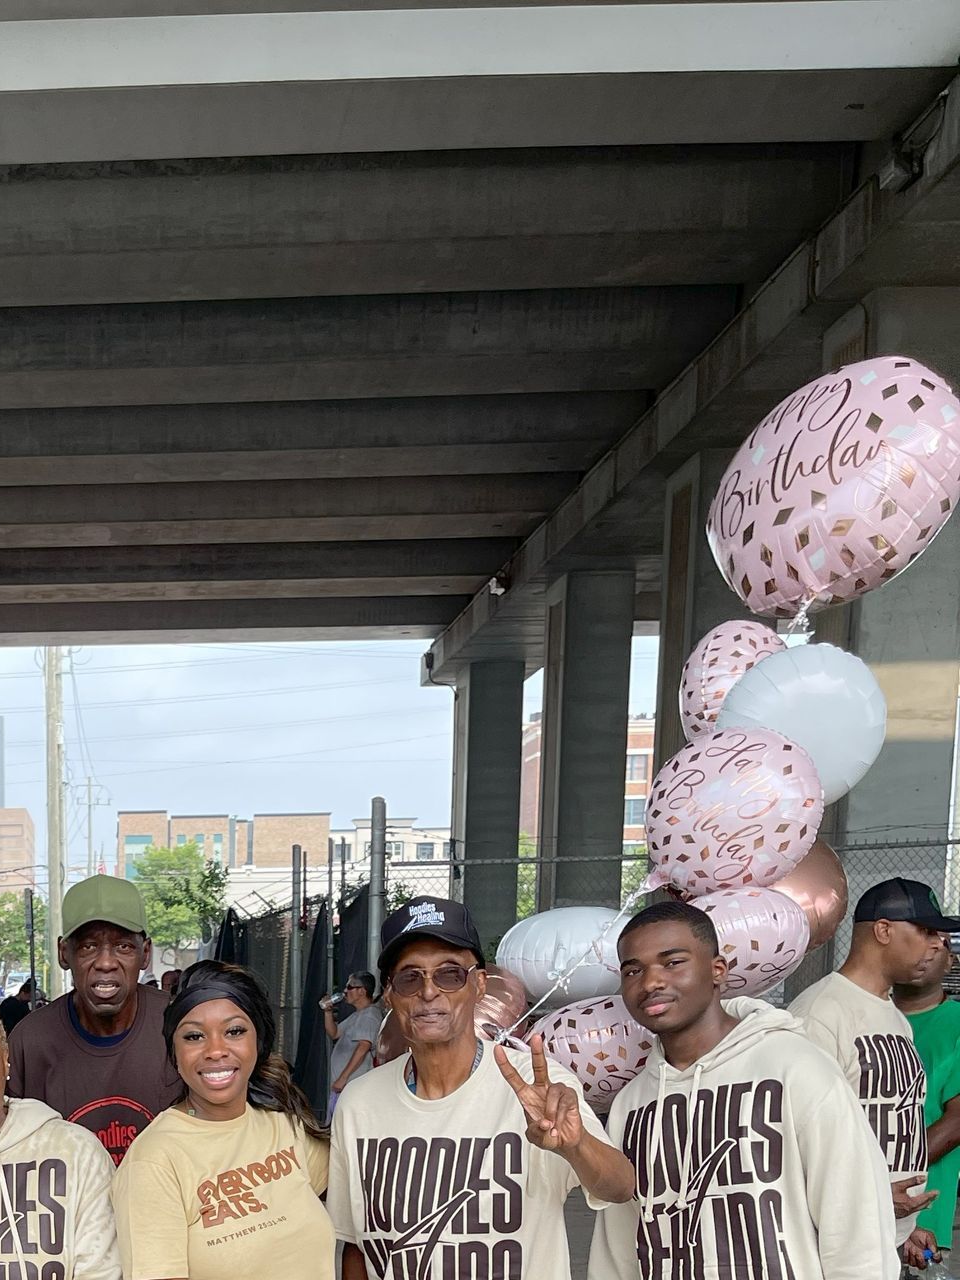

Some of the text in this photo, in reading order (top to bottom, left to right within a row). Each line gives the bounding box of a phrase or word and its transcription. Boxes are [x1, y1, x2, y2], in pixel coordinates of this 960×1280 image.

[197, 1145, 302, 1205] EVERYBODY
[623, 1079, 783, 1201] HOODIES
[357, 1132, 523, 1234] HOODIES
[206, 1225, 257, 1248] MATTHEW
